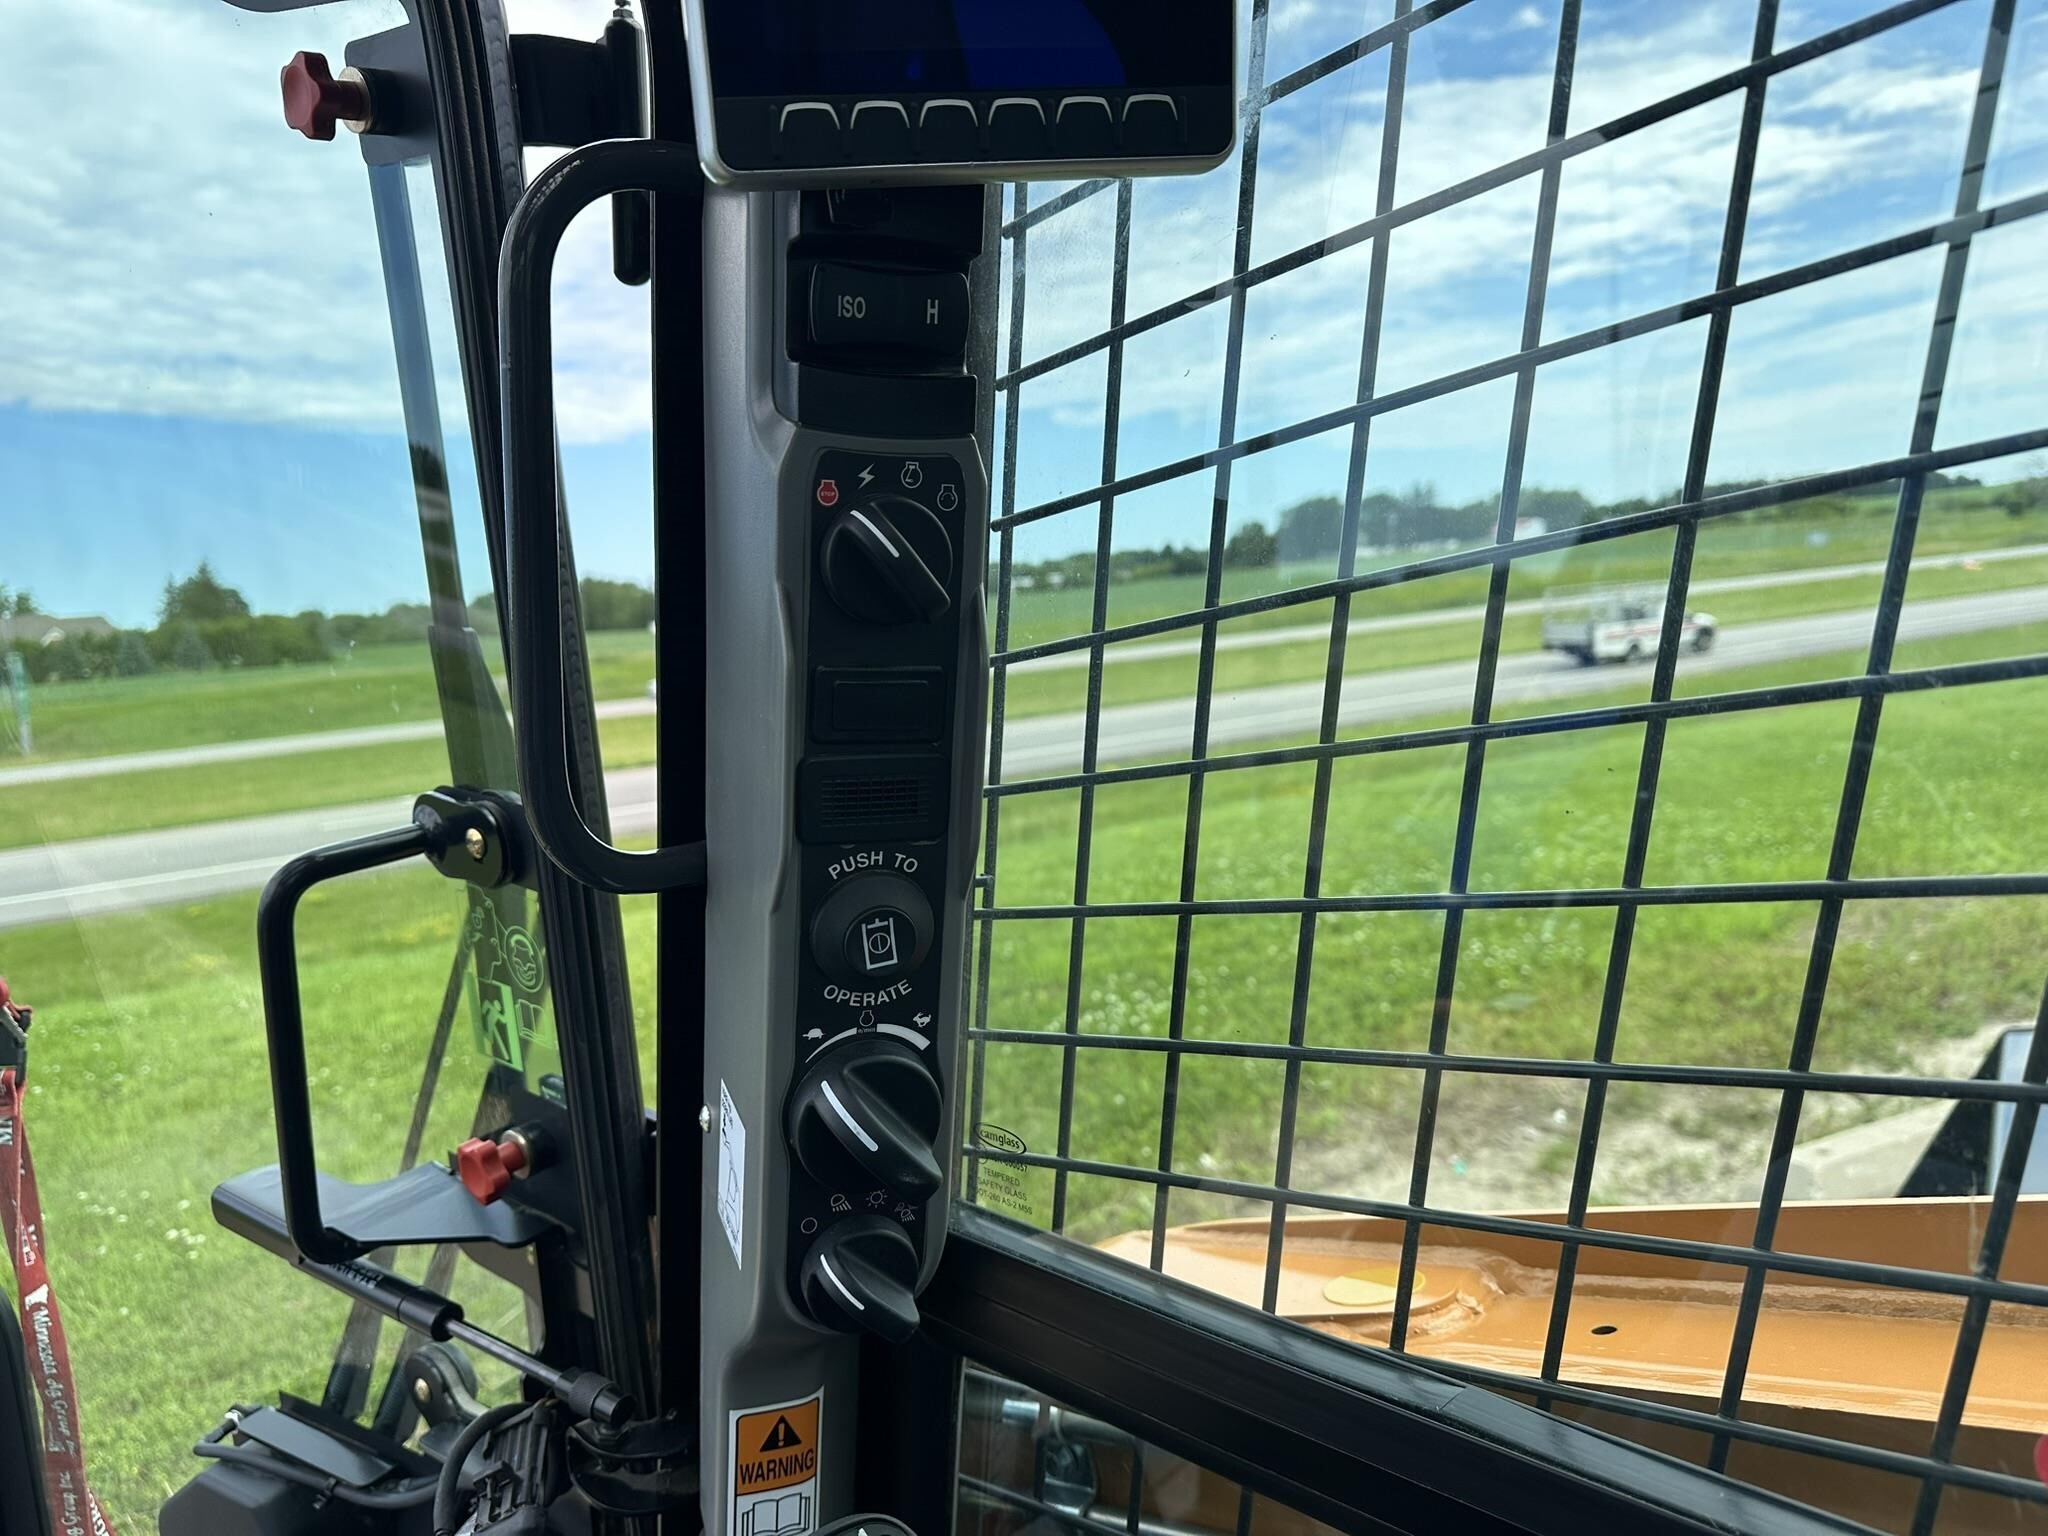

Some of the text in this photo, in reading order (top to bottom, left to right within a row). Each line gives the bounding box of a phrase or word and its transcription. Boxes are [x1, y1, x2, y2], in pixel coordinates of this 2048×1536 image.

[837, 296, 866, 319] ISO
[926, 299, 939, 325] H
[828, 850, 919, 880] PUSH TO
[823, 978, 913, 1007] OPERATE
[980, 1127, 1020, 1149] camglass
[983, 1166, 1021, 1187] TEMPERED
[739, 1448, 815, 1485] WARNING
